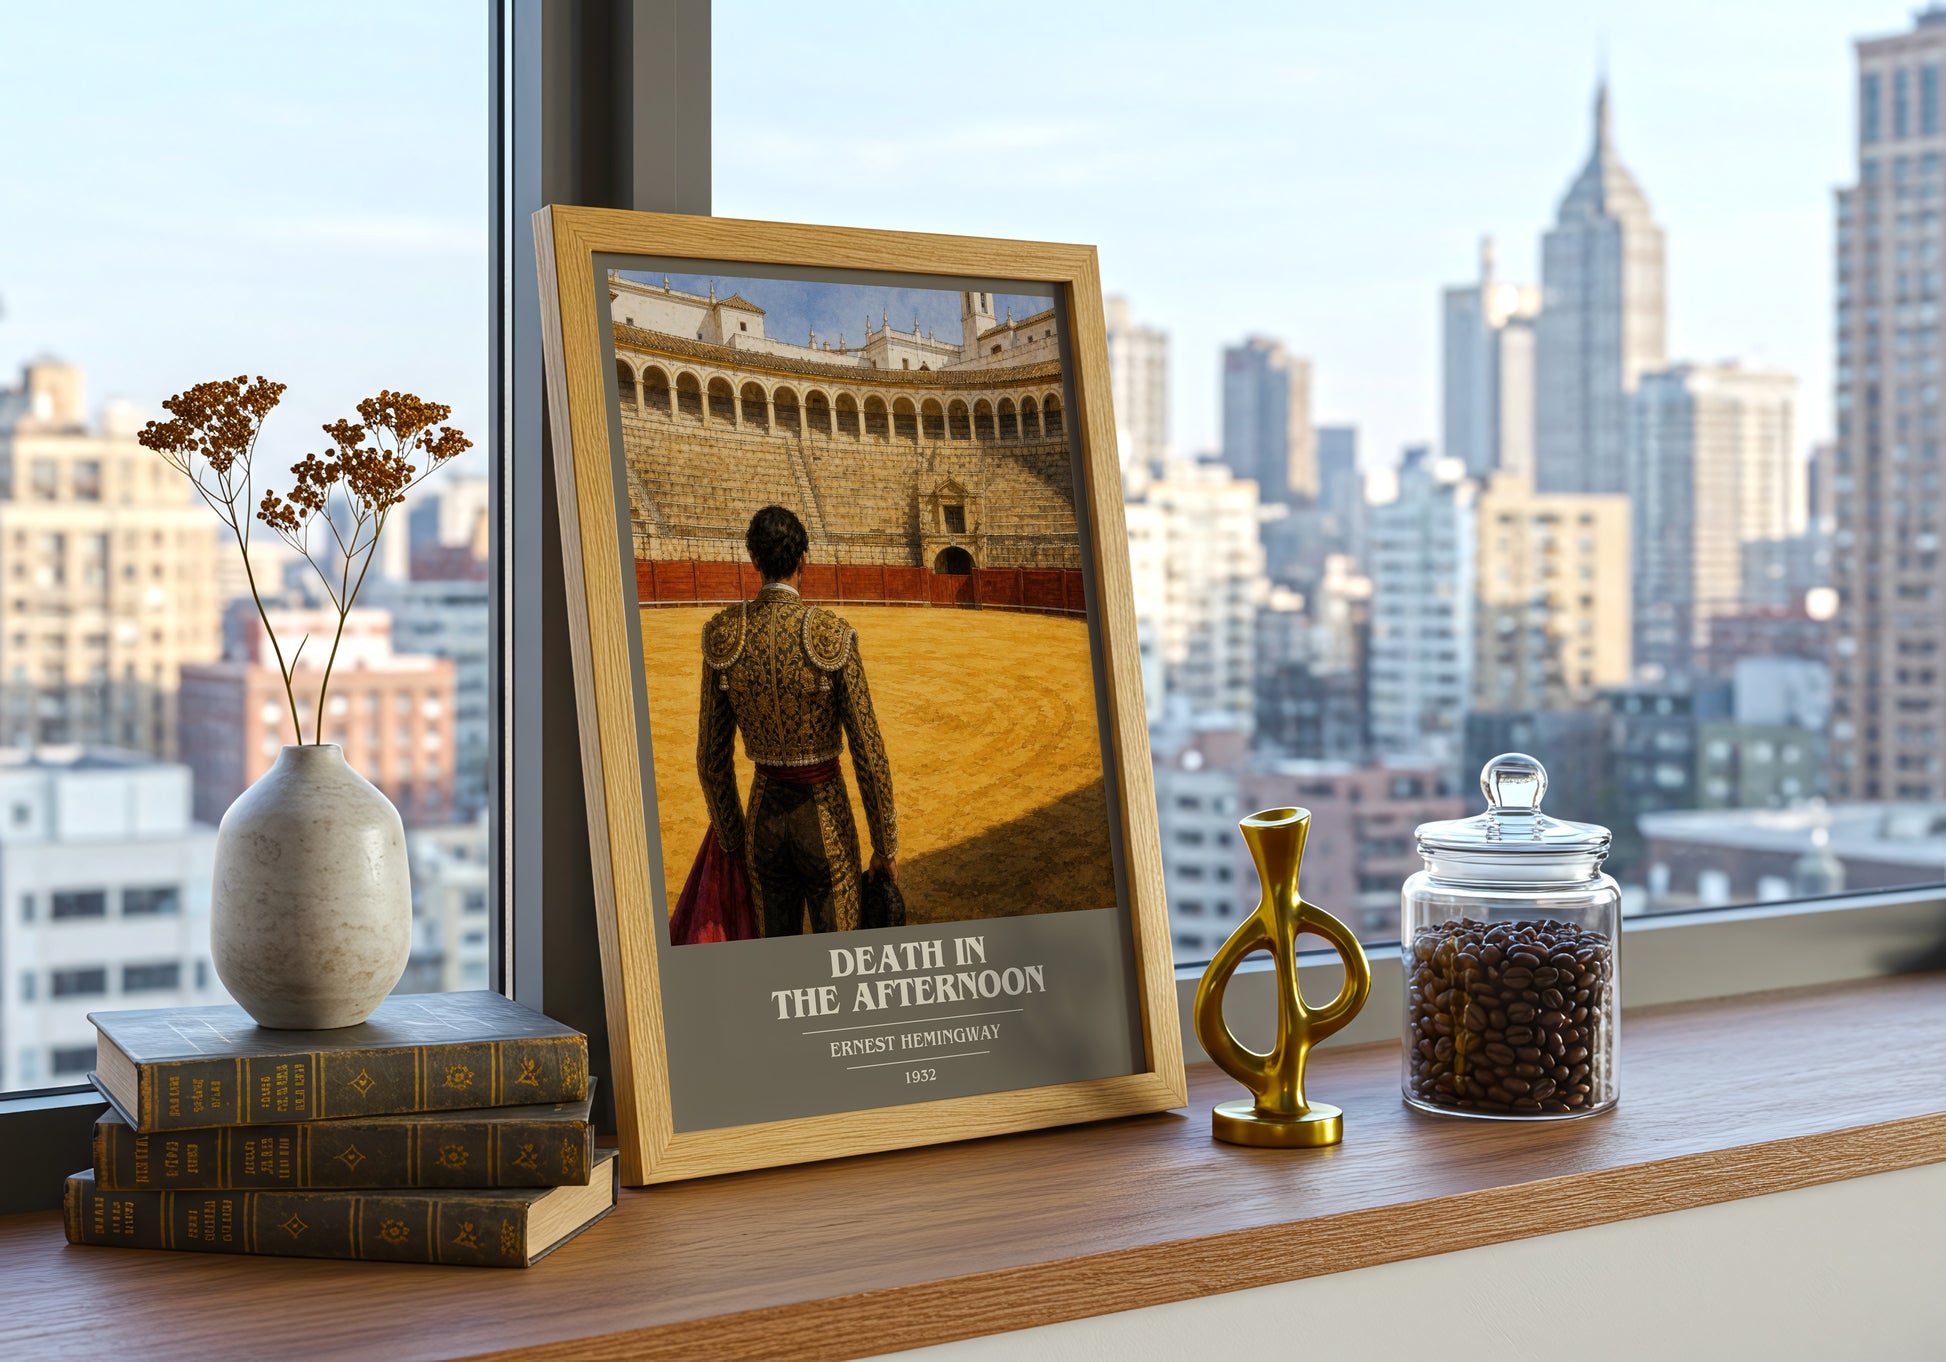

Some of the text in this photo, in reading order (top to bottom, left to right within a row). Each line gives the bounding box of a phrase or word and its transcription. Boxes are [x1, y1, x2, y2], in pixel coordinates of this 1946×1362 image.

[828, 935, 987, 978] DEATH IN
[771, 964, 1047, 1020] THE AFTERNOON
[830, 1023, 1001, 1058] ERNEST HEMINGWAY
[905, 1068, 937, 1084] 1932
